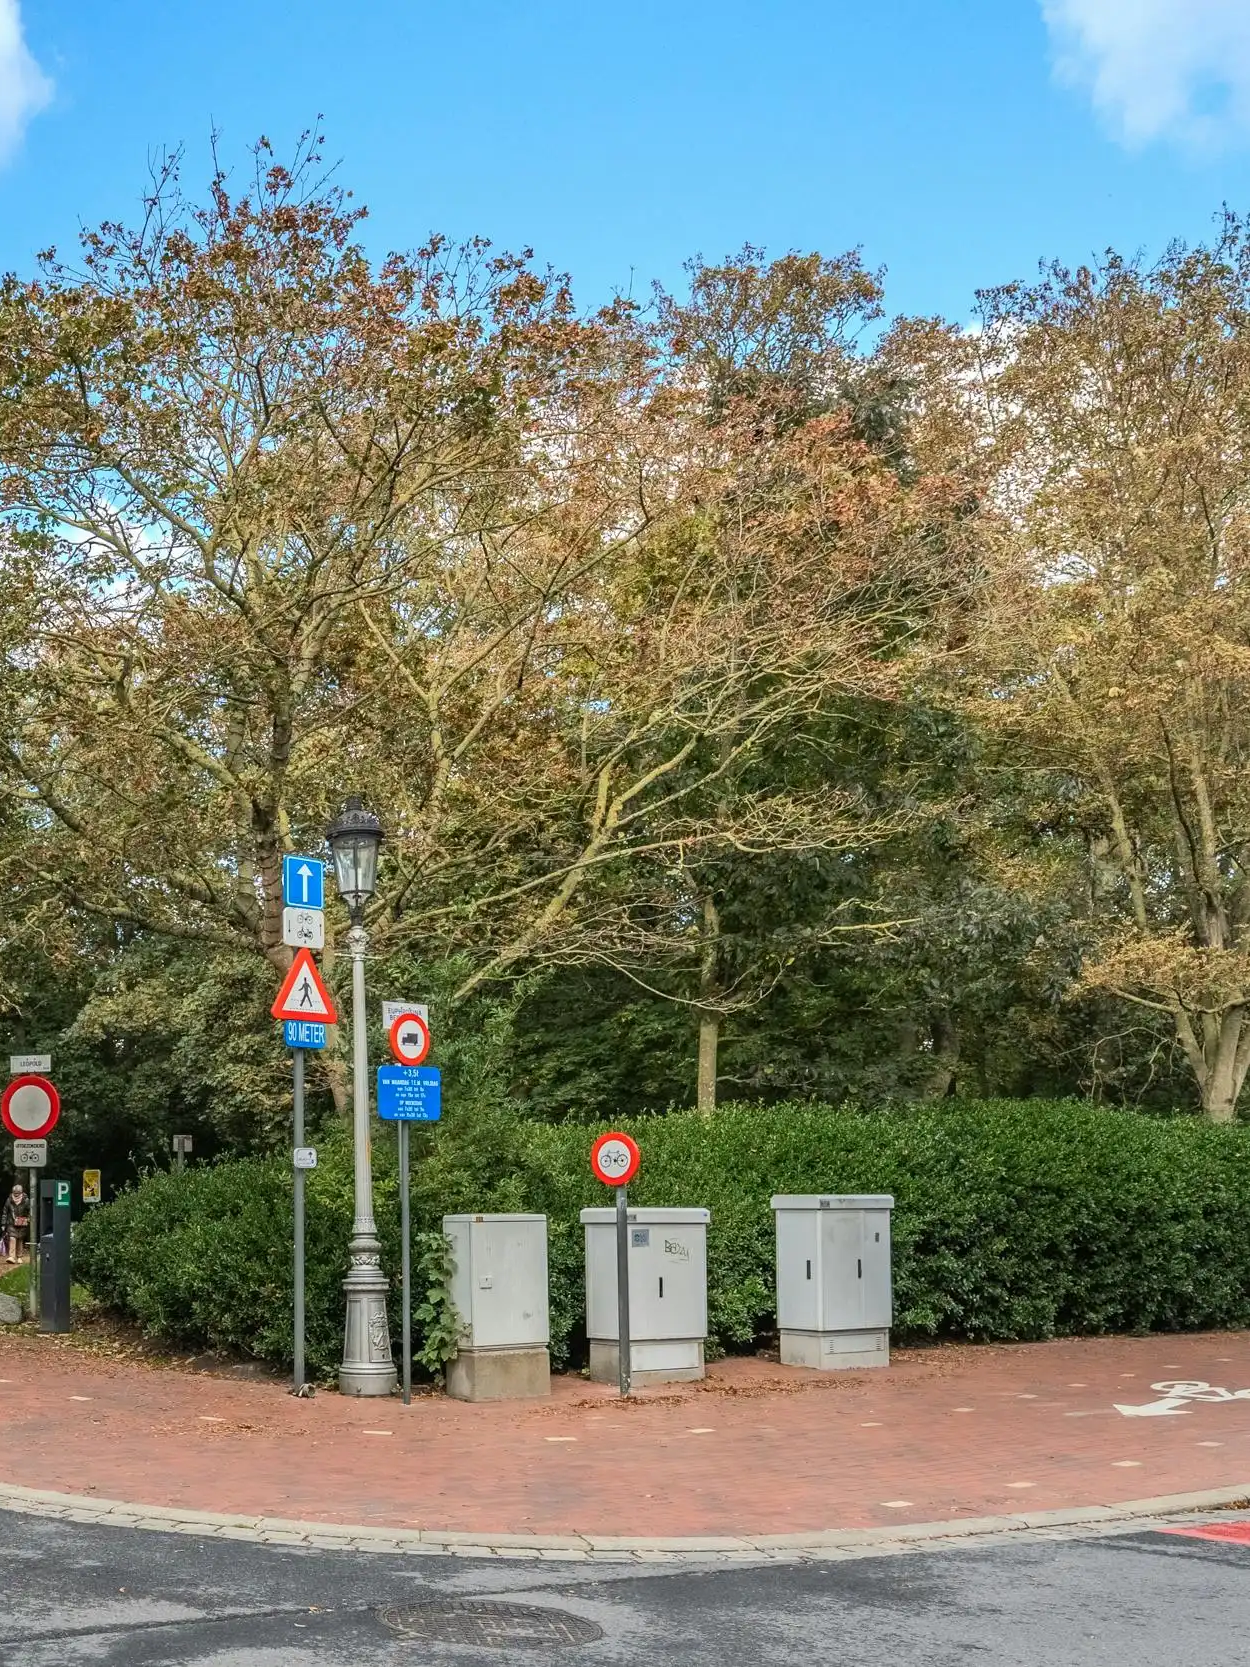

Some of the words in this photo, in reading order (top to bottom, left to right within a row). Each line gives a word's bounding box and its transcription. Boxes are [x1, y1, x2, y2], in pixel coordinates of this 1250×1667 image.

[288, 1022, 298, 1041] 90
[298, 1023, 325, 1044] METER
[57, 1182, 69, 1201] P
